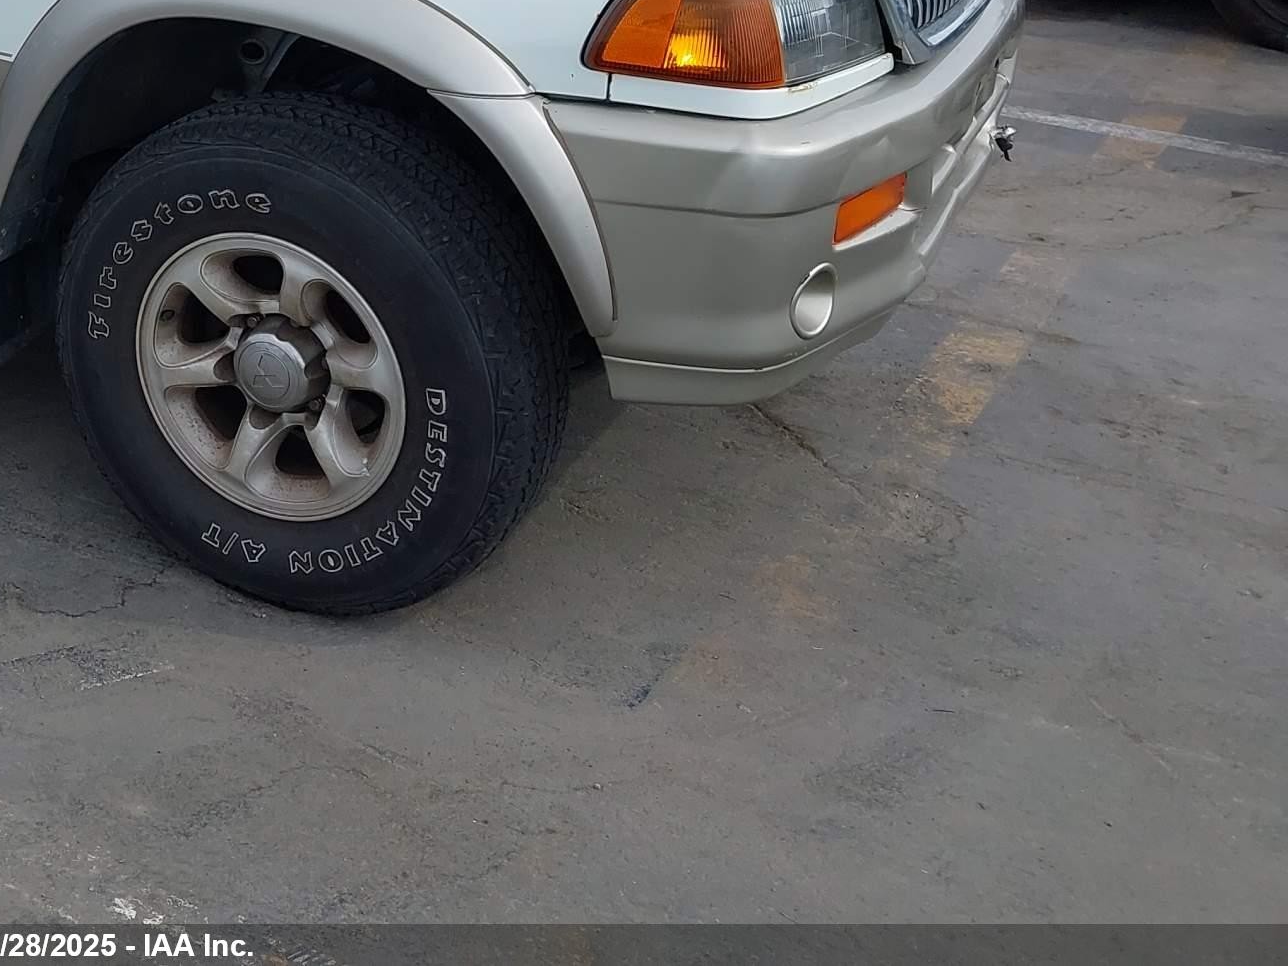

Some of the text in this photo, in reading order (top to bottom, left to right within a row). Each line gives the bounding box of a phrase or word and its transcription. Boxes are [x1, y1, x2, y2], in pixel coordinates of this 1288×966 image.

[87, 189, 272, 340] Firestone
[202, 387, 449, 575] DESTINATION A/T
